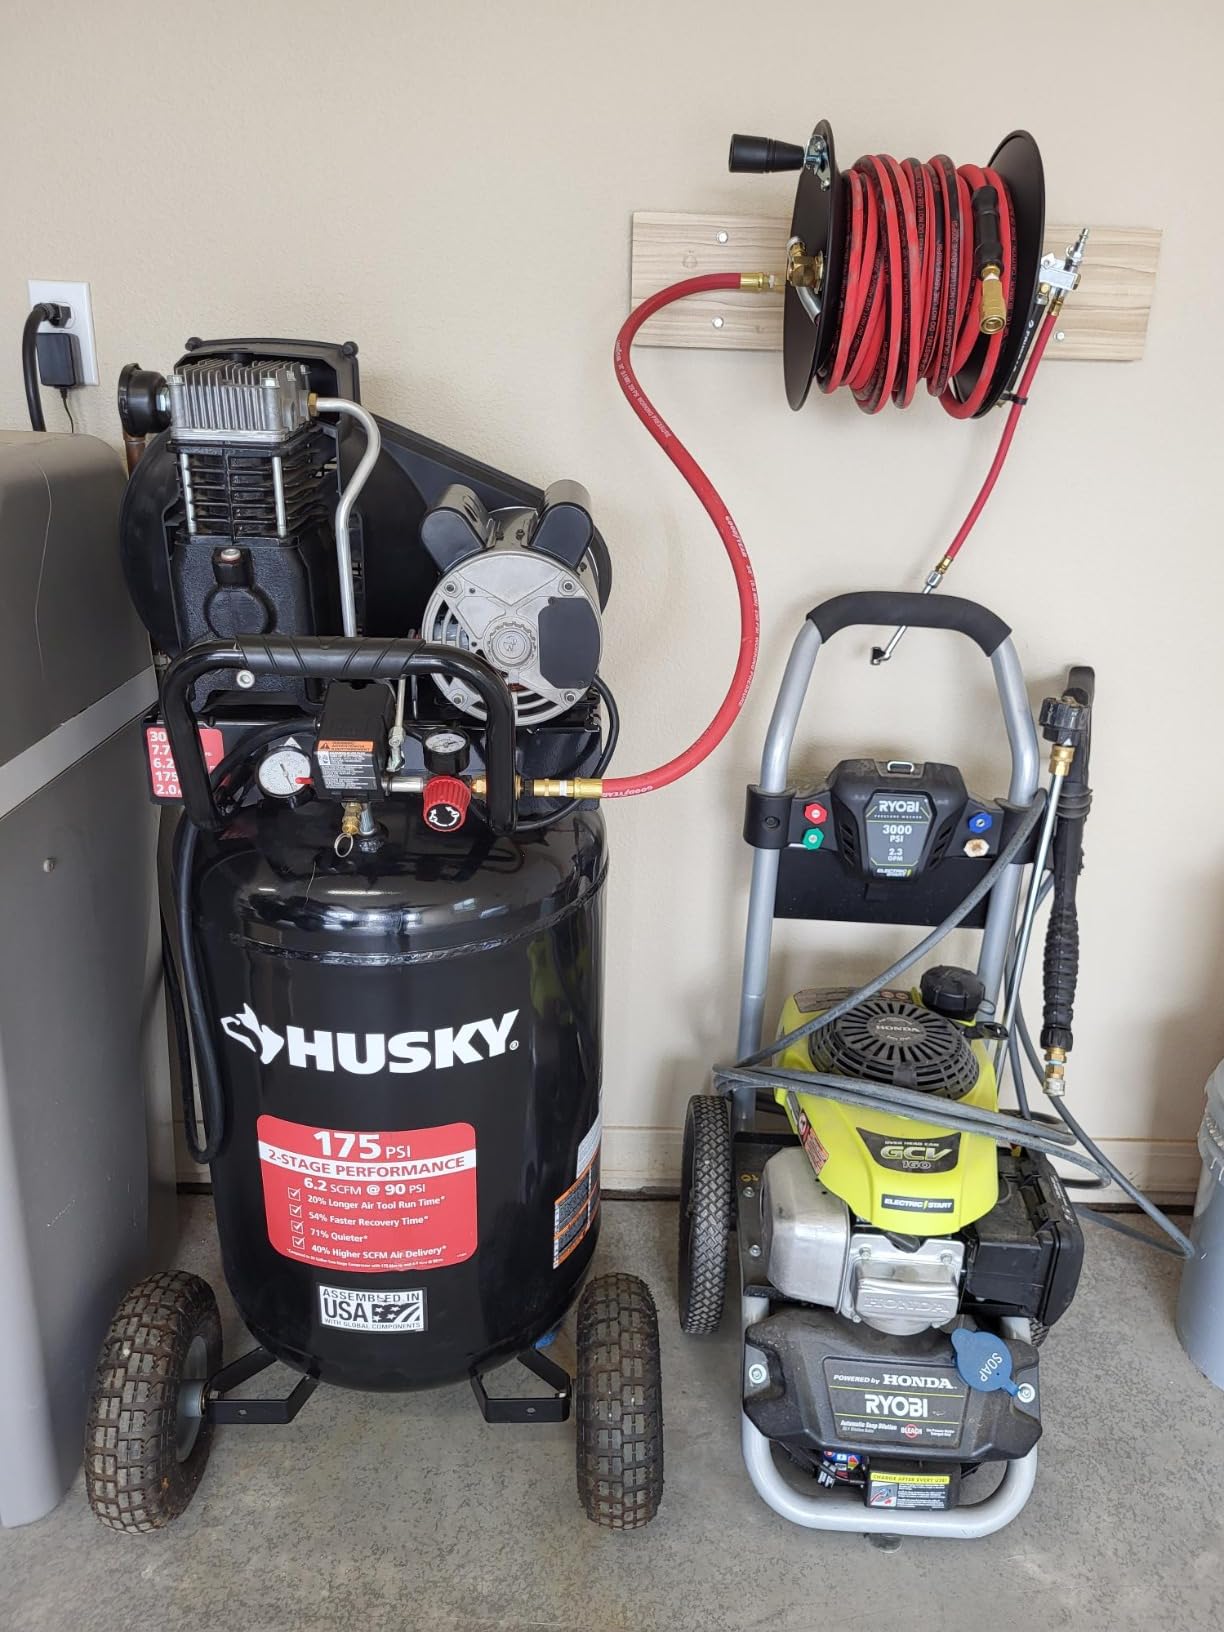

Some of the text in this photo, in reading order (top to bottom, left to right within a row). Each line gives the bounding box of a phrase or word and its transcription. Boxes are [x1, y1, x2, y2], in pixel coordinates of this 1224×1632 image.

[602, 785, 654, 797] GOODYEAR
[879, 800, 920, 813] RYOBI
[882, 824, 912, 835] 3000
[889, 835, 904, 843] PSI
[888, 848, 904, 856] 2.3
[875, 1024, 921, 1033] HONDA
[312, 1130, 412, 1160] 175 PSI
[880, 1145, 953, 1161] GCV
[268, 1148, 465, 1178] 2-STAGE PERFORMANCE
[901, 1160, 932, 1170] 160
[303, 1177, 426, 1196] 6.2 SCFM @ 90 PSI
[307, 1194, 327, 1206] 20%
[328, 1198, 359, 1210] Longer
[361, 1201, 374, 1210] Air
[376, 1201, 397, 1210] Tool
[398, 1200, 417, 1209] Run
[884, 1198, 924, 1208] ELECTRIC
[308, 1211, 328, 1223] 54%
[329, 1215, 356, 1226] Faster
[358, 1218, 400, 1228] Recovery
[310, 1227, 330, 1239] 71%
[311, 1244, 331, 1256] 40%
[332, 1248, 361, 1260] Higher
[362, 1250, 388, 1259] SCFM
[390, 1250, 403, 1259] Air
[322, 1288, 420, 1303] ASSEMBLED IN
[324, 1297, 369, 1323] USA
[325, 1318, 421, 1330] WITH GLOBAL COMPONENTS
[979, 1352, 1003, 1382] SOAP
[833, 1373, 954, 1390] POWERED by HONDA
[864, 1393, 928, 1418] RYOBI
[901, 1426, 922, 1435] BLEACH
